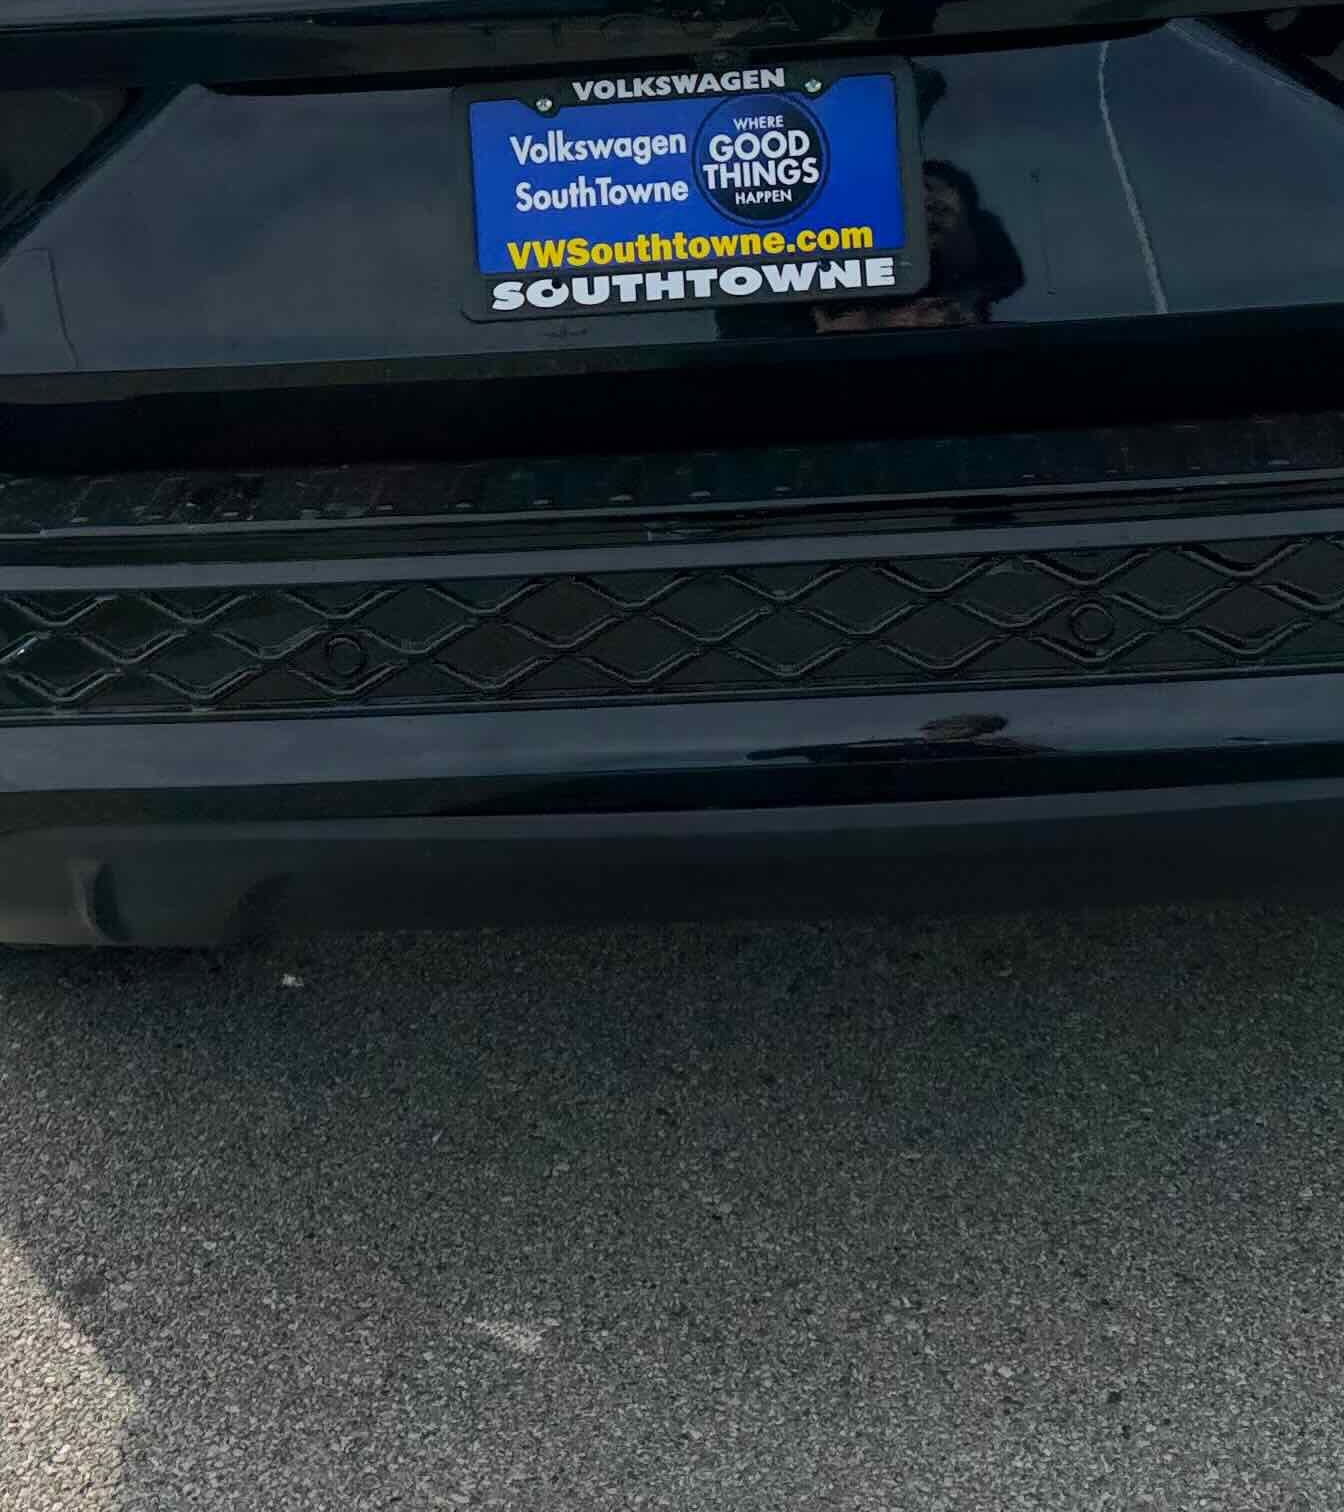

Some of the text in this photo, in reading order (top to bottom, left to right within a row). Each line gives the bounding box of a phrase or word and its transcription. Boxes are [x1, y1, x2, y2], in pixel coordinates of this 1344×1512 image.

[572, 67, 785, 102] VOLKSWAGEN
[733, 115, 784, 130] WHERE
[510, 131, 686, 165] Volkswagen
[709, 129, 810, 162] GOOD
[703, 157, 819, 191] THINGS
[515, 176, 689, 212] SouthTowne
[735, 189, 792, 205] HAPPEN
[507, 225, 873, 270] VWSouthtowne.com
[491, 257, 895, 311] SOUTHTOWNE
